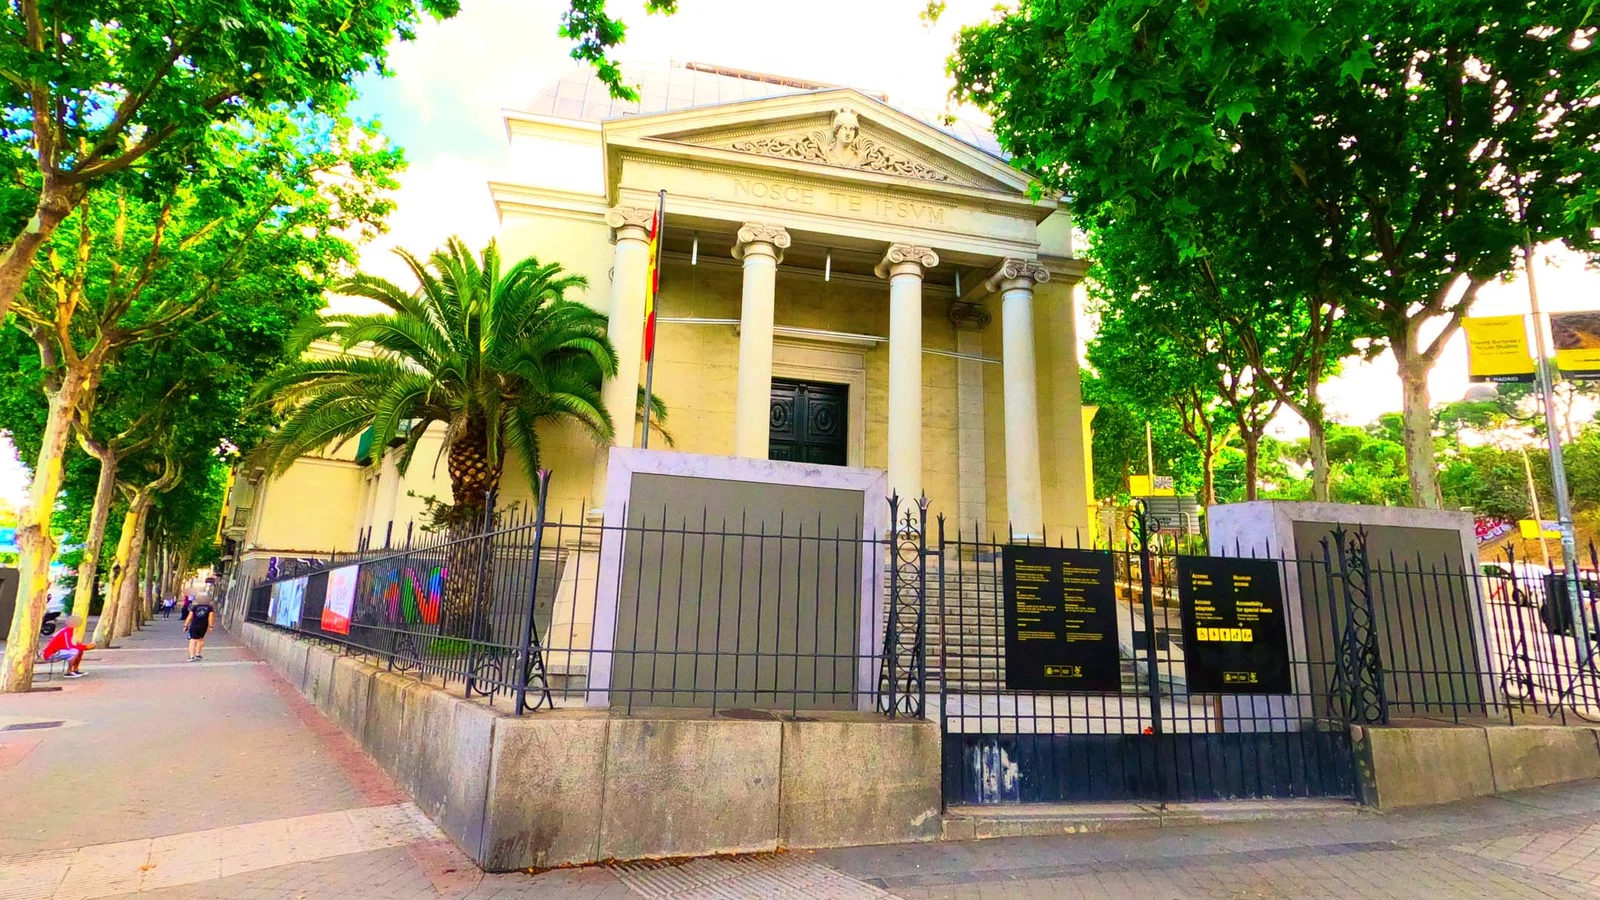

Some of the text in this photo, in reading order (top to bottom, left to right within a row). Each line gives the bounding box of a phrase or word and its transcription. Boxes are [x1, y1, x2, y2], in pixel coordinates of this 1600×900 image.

[734, 178, 946, 225] NOSCE TE IPSVM
